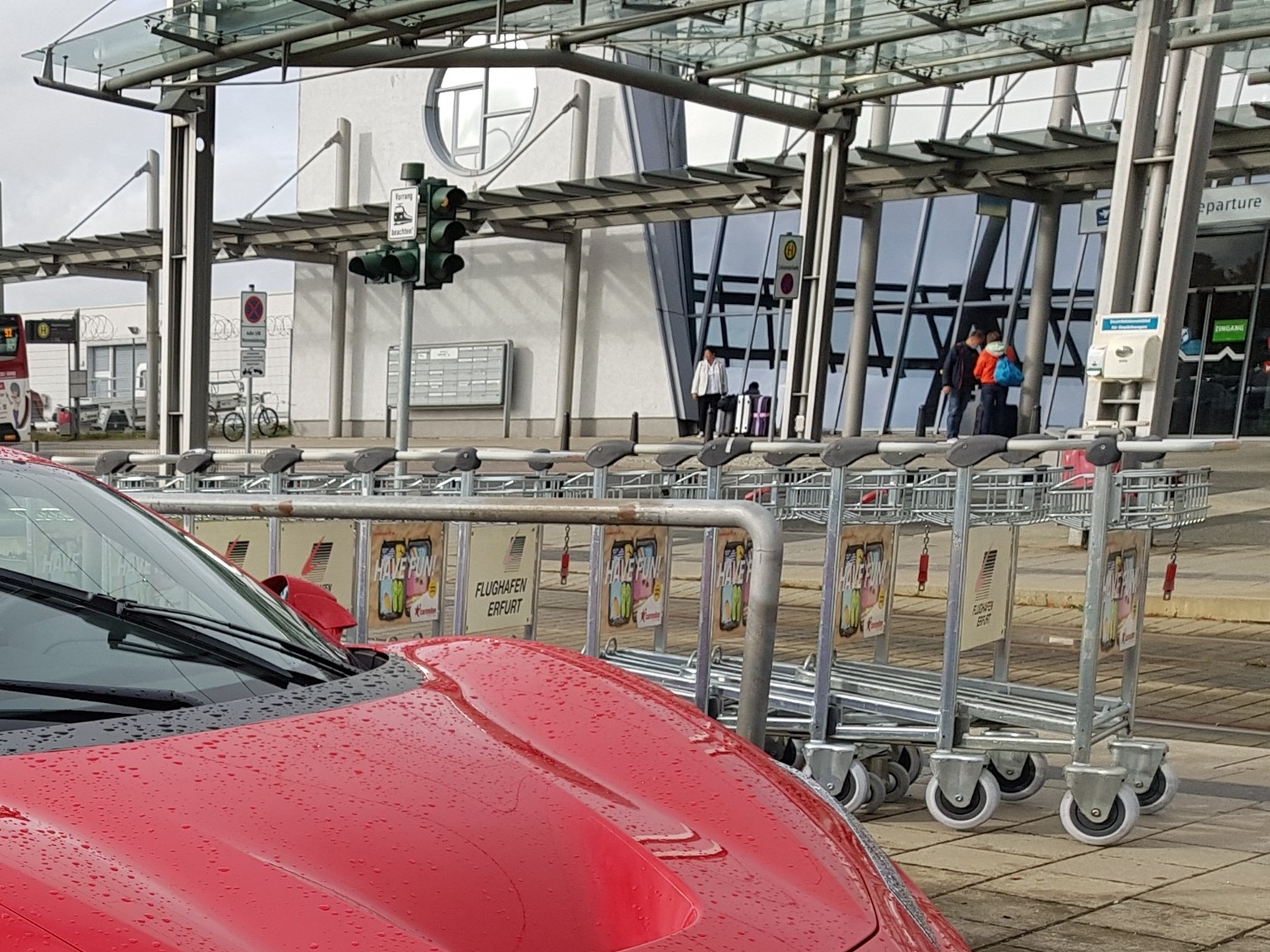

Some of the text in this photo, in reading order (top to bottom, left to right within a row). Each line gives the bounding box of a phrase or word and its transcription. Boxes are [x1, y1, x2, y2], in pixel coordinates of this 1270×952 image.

[395, 193, 413, 201] Vorrang
[1199, 197, 1262, 215] eparture
[373, 555, 438, 582] HAVE FUN!
[604, 555, 663, 584] HAVE FUN!
[838, 560, 888, 593] HAVE FUN!
[474, 577, 529, 598] FLUGHAFEN
[487, 598, 523, 617] ERFURT
